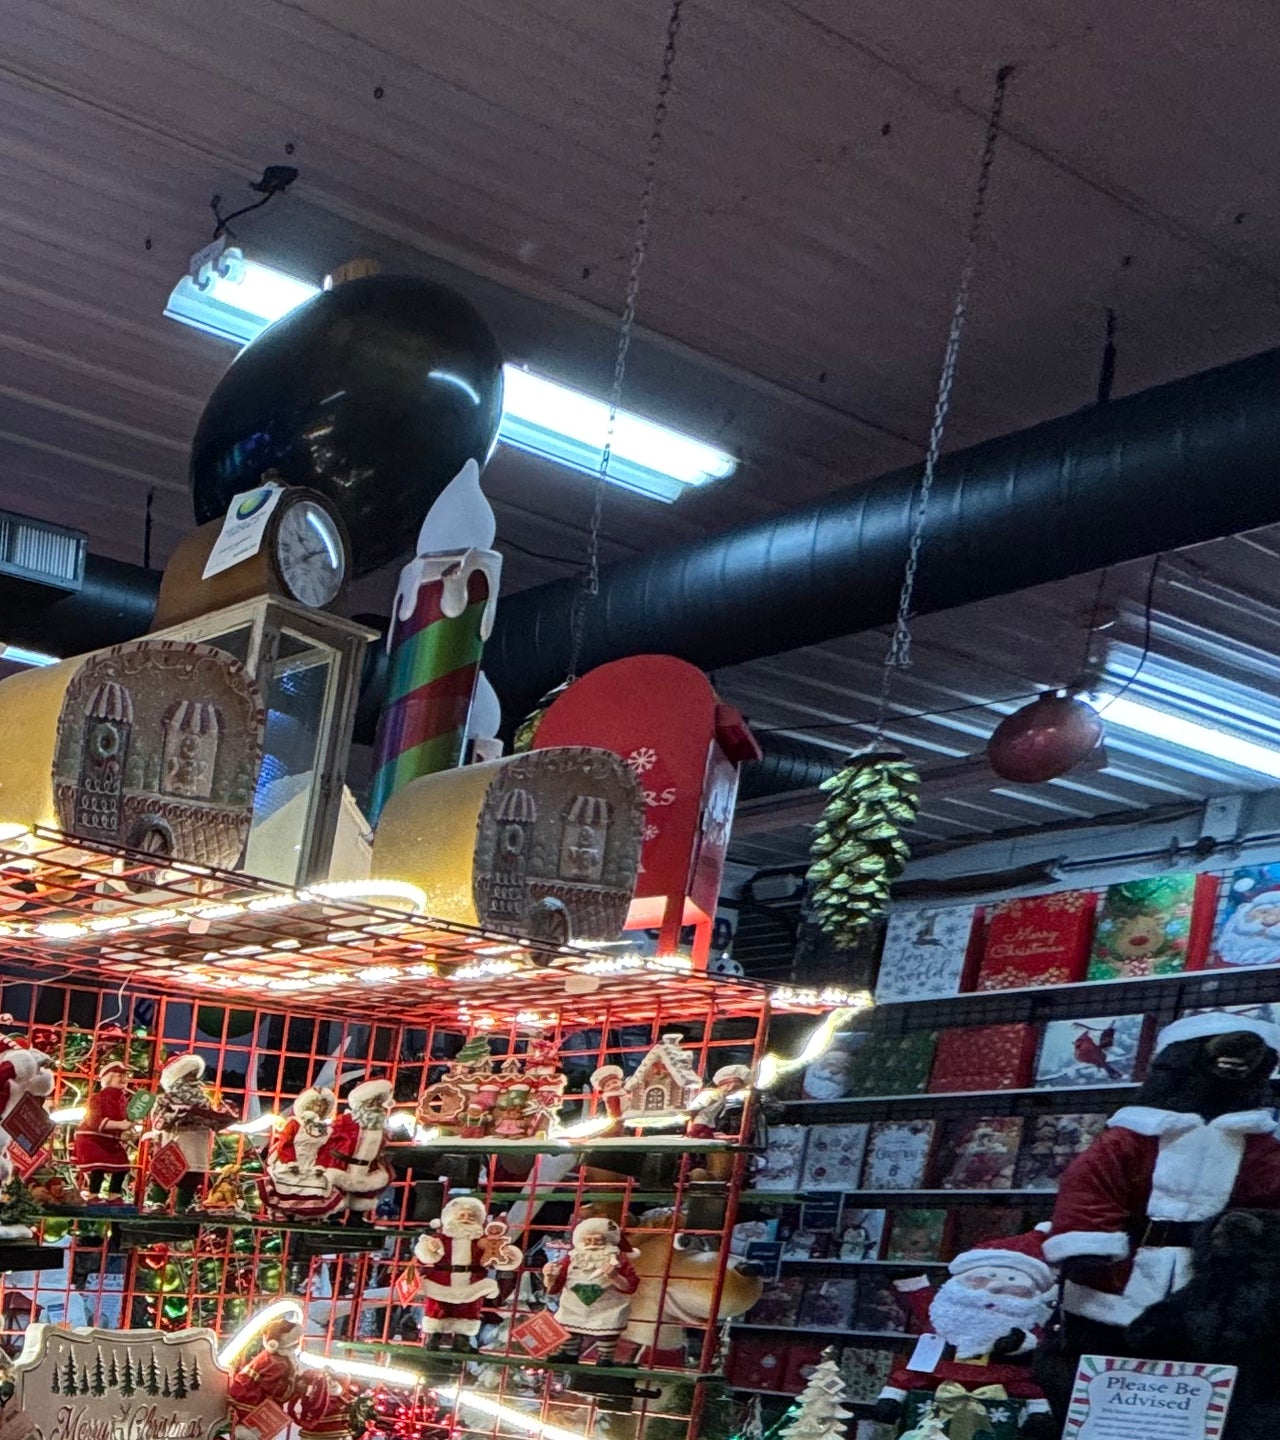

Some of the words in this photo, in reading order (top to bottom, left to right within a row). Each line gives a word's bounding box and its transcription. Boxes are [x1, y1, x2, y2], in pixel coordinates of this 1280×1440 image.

[1002, 926, 1061, 944] Merry
[1106, 1376, 1169, 1394] Please
[1175, 1382, 1201, 1397] Be
[1108, 1391, 1191, 1411] Advised
